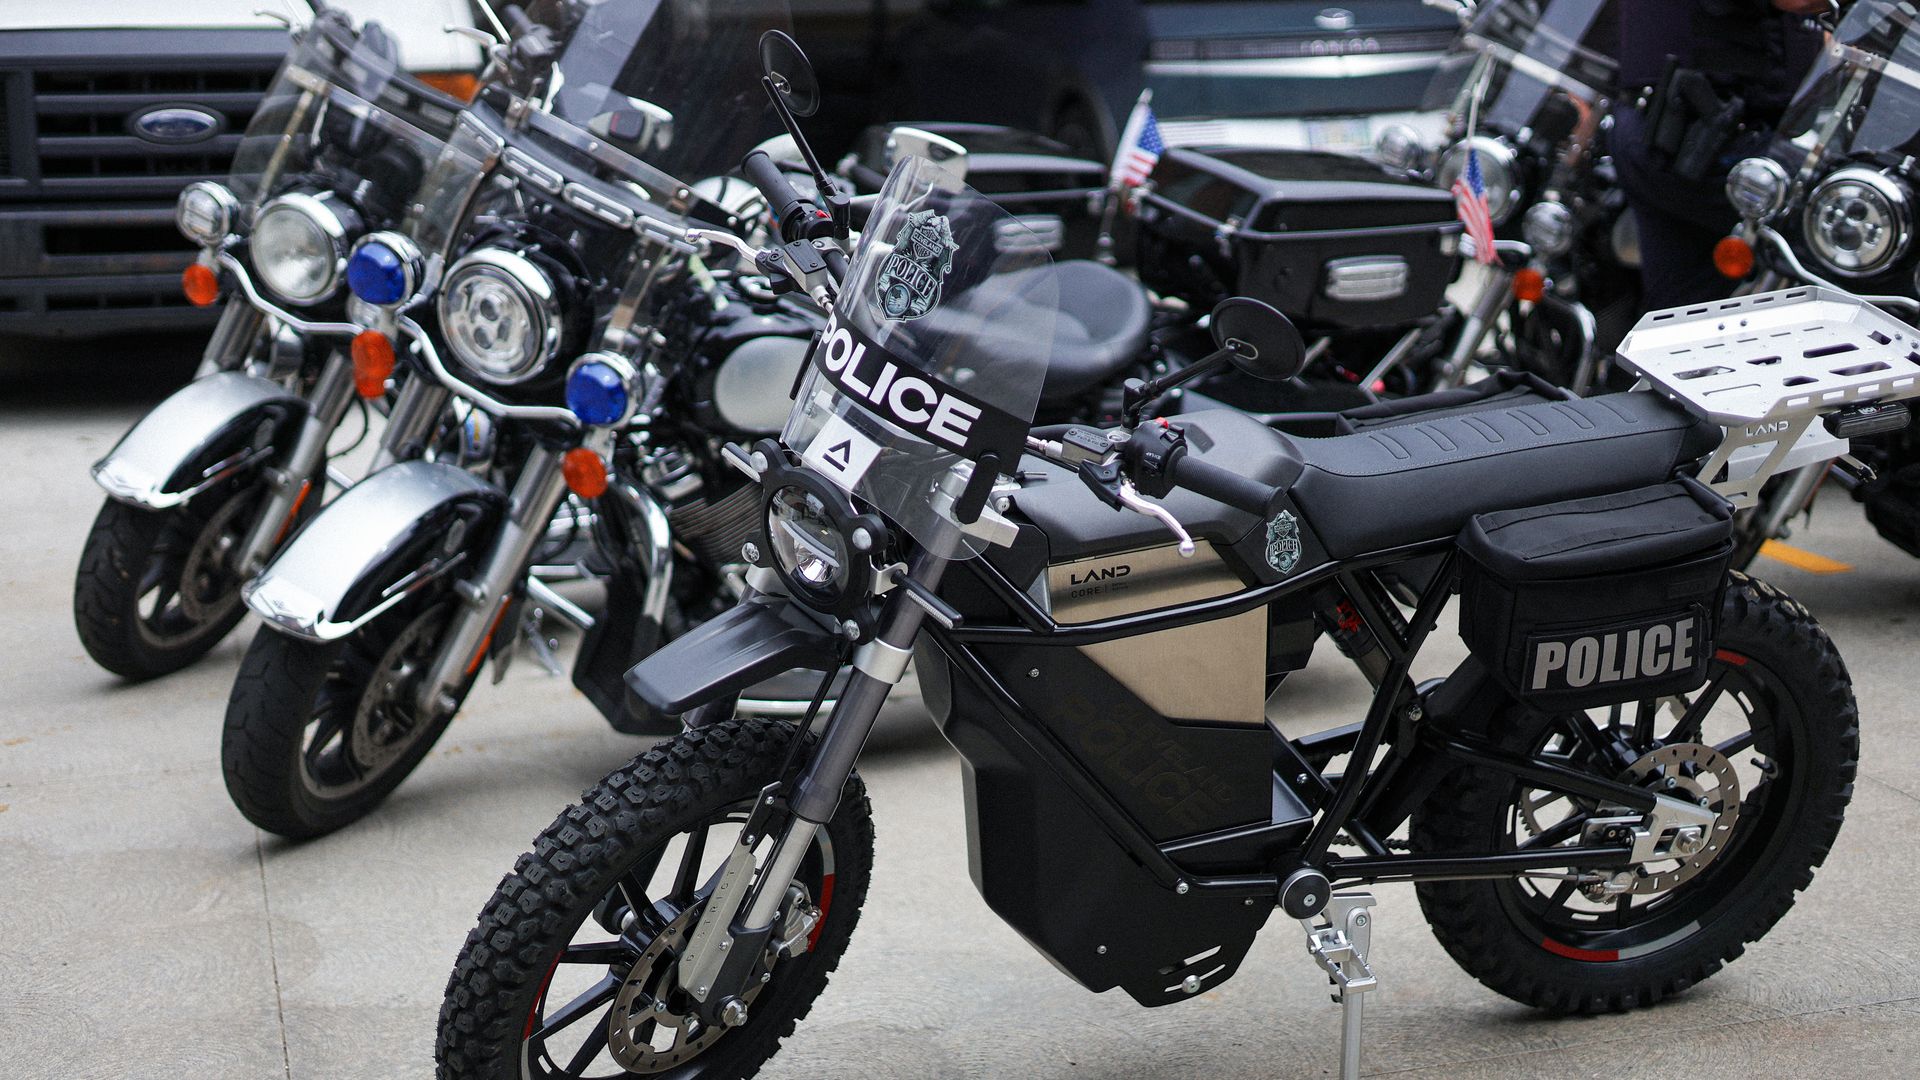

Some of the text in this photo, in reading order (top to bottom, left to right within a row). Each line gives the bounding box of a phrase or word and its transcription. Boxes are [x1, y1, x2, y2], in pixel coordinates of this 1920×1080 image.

[913, 232, 940, 253] CLEVELAND
[887, 255, 935, 298] POLICE
[818, 312, 982, 448] POLICE
[1745, 420, 1789, 437] LAND
[1070, 564, 1131, 586] LAND
[1071, 586, 1104, 600] CORE
[1531, 617, 1694, 690] POLICE
[1050, 693, 1217, 832] POLICE
[685, 870, 737, 962] DSTRICT
